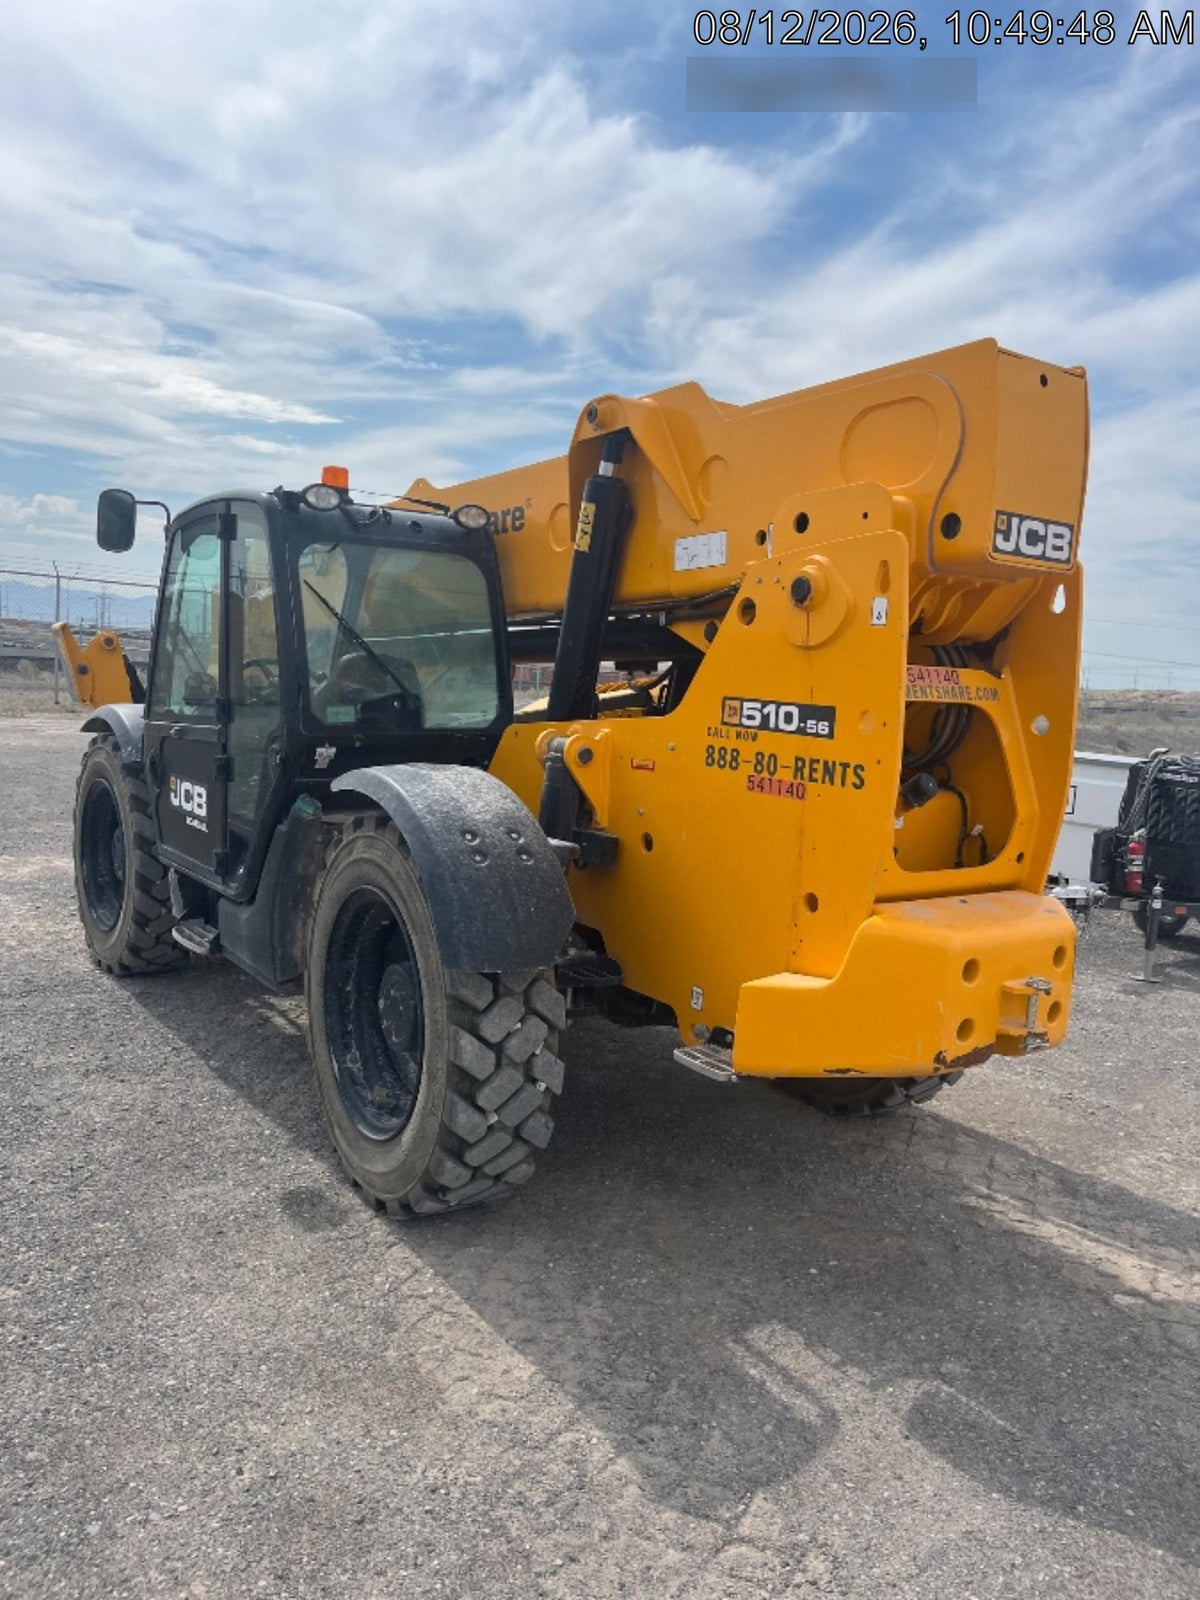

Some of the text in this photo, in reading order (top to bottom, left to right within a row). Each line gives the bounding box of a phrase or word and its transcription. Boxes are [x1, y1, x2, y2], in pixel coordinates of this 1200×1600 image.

[995, 516, 1072, 561] JCB
[907, 667, 960, 685] 541140
[706, 726, 758, 742] CALL NOW
[705, 744, 865, 790] 888-80-RENTS
[169, 778, 207, 817] JCB
[747, 774, 806, 800] 541140
